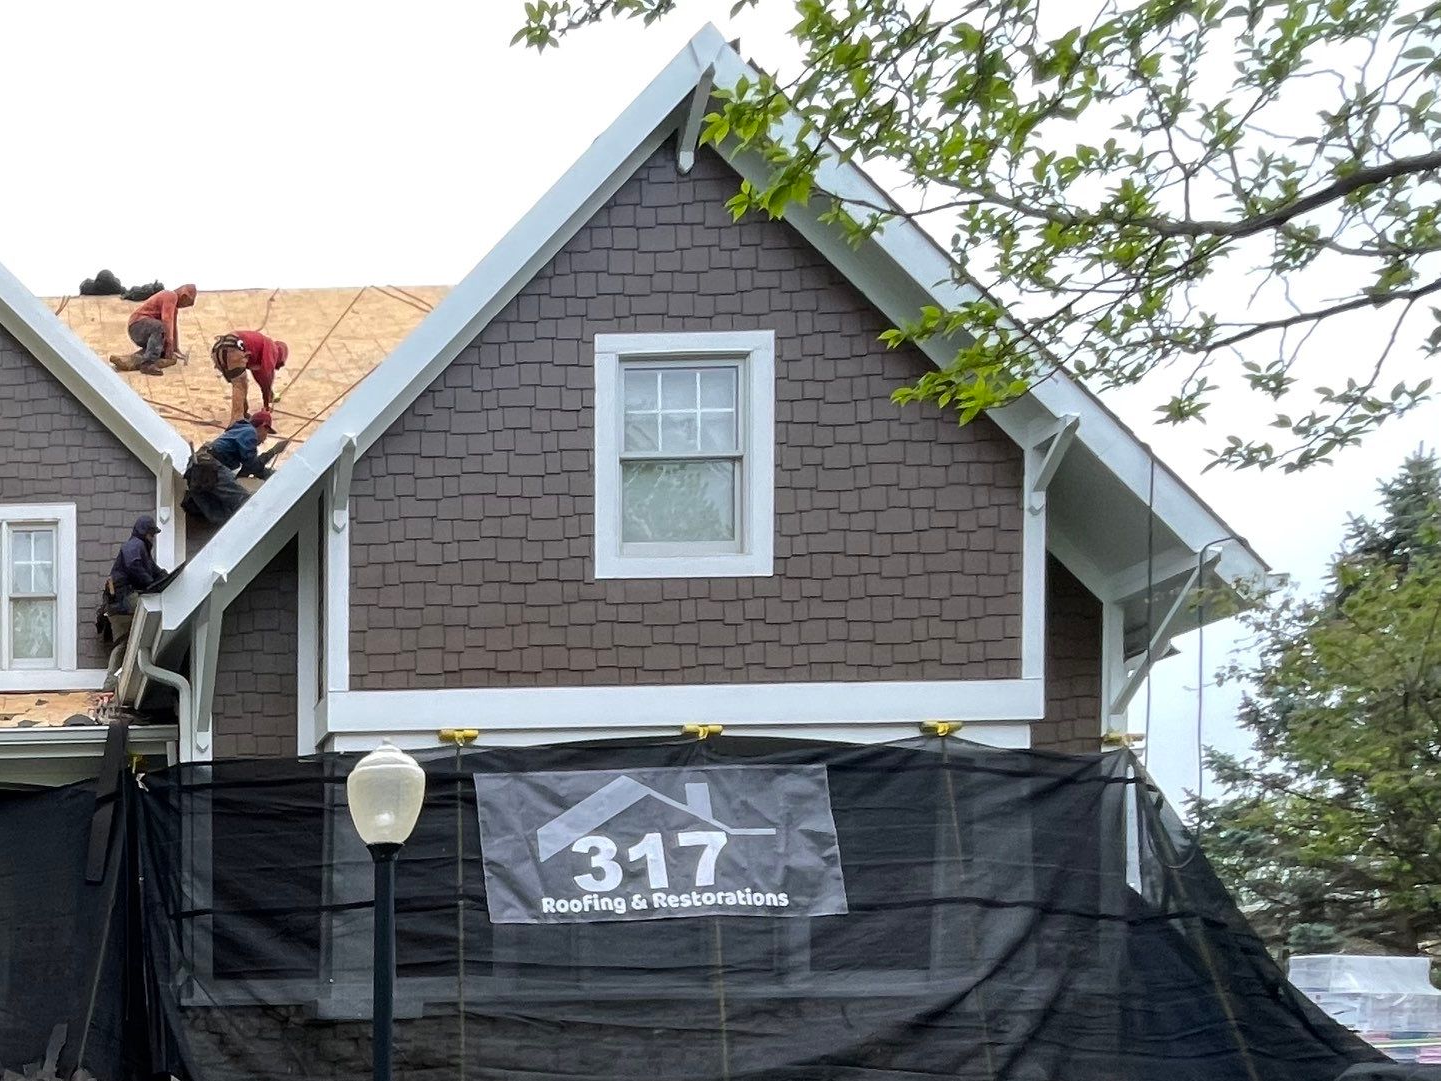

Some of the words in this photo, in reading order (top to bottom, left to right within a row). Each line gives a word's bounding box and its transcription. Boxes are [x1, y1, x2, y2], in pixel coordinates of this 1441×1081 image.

[571, 831, 728, 892] 317
[541, 895, 627, 914] Roofing
[631, 894, 647, 910] &
[652, 888, 789, 908] Restorations
